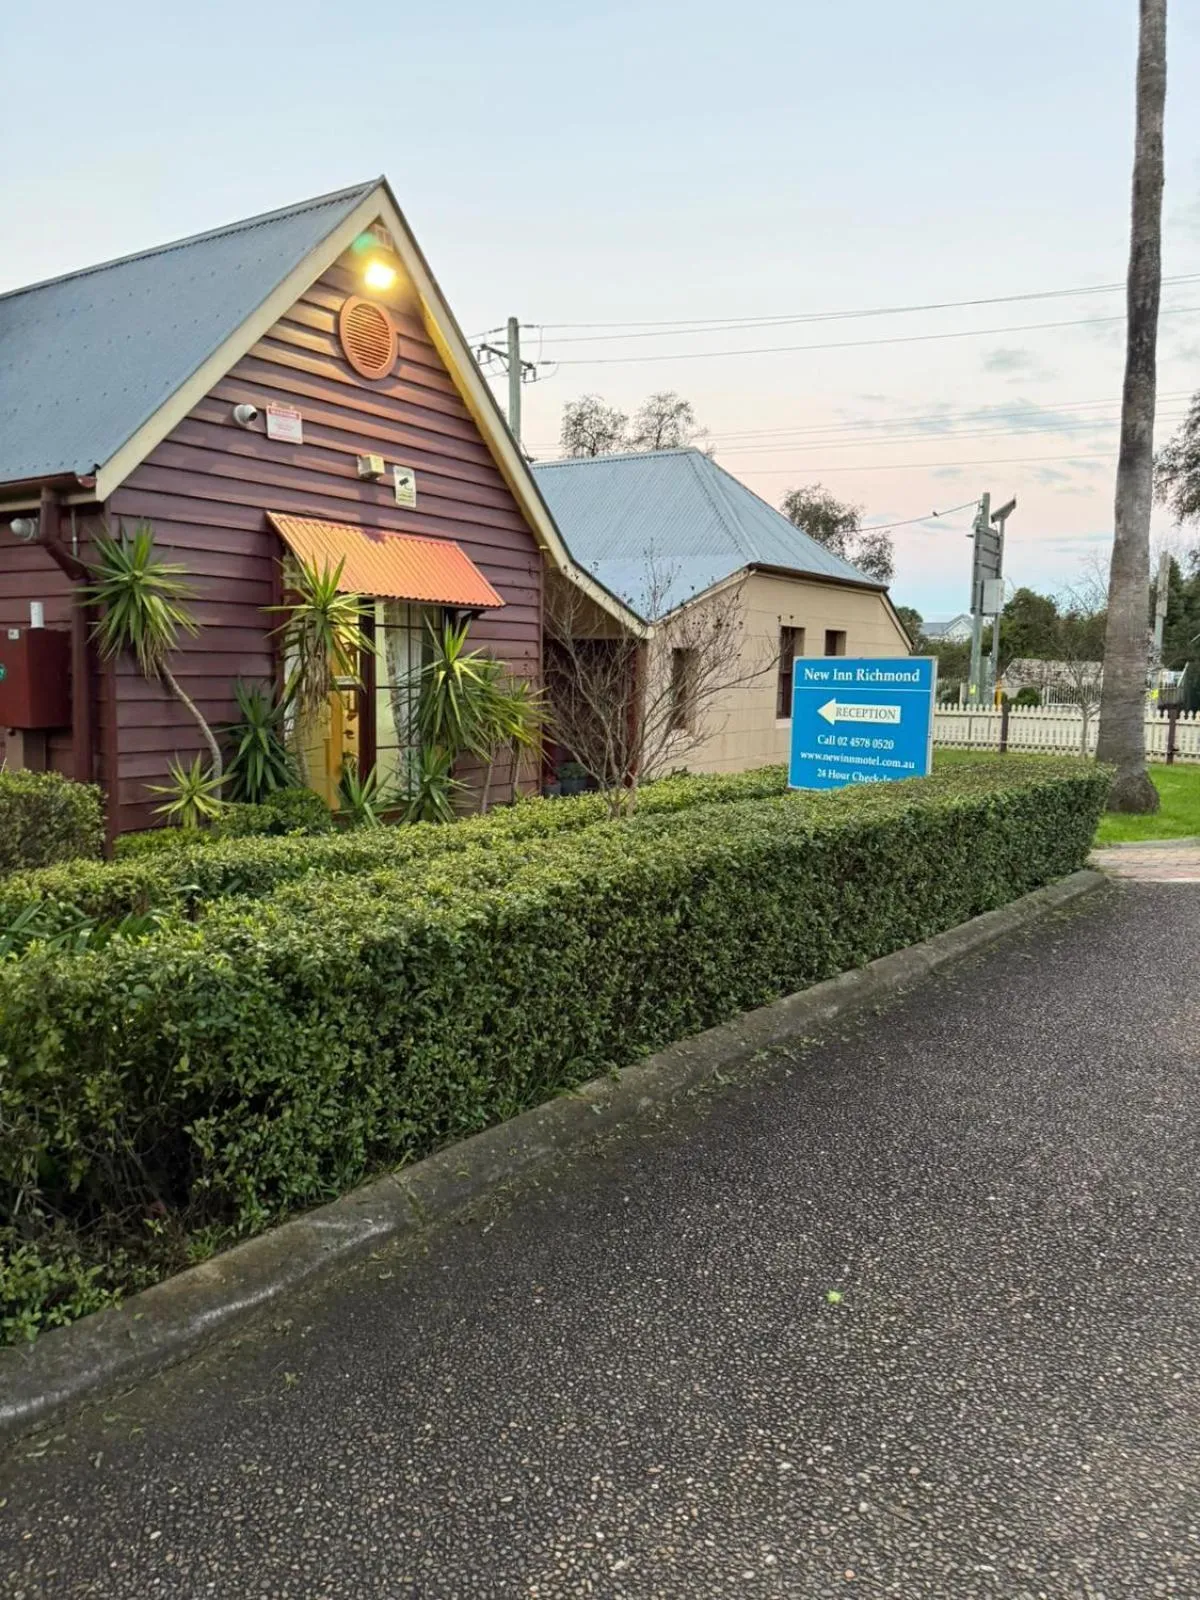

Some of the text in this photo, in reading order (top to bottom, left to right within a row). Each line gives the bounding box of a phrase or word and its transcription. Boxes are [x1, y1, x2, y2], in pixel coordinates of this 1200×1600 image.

[804, 667, 920, 682] New Inn Richmond
[835, 707, 897, 720] RECEPTION
[817, 734, 894, 750] Call 02 4578 0520
[800, 751, 915, 769] www.newinnmotel.com.au
[817, 768, 826, 777] 24
[828, 769, 849, 780] Hour
